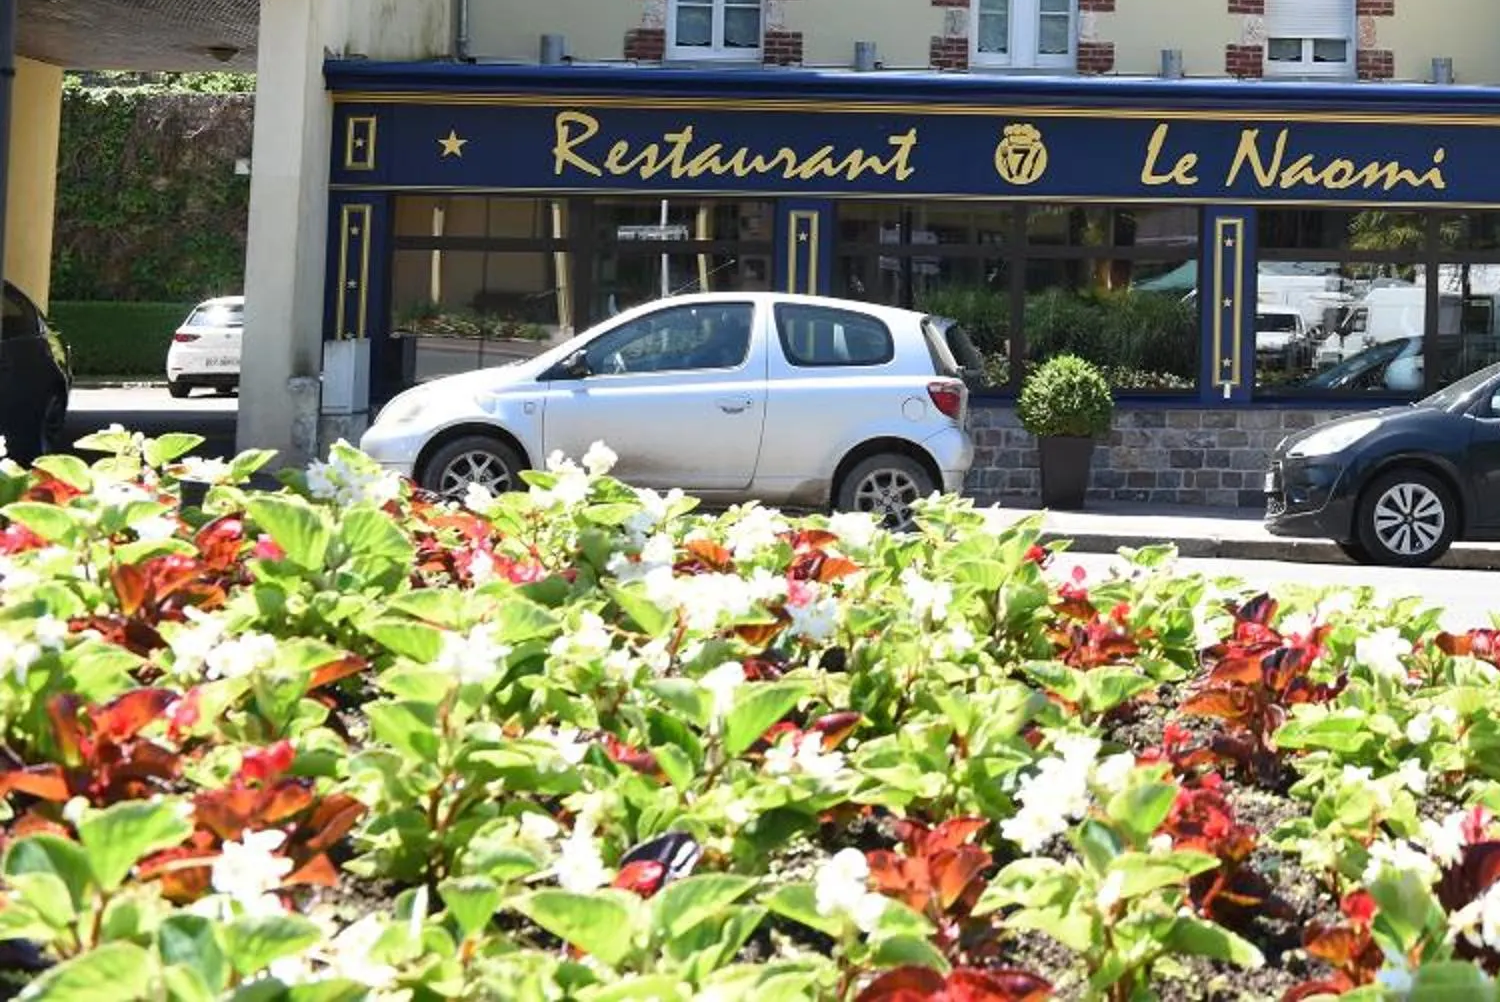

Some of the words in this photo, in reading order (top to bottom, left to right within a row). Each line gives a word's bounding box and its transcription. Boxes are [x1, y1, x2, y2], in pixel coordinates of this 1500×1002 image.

[552, 110, 917, 181] Restaurant
[1141, 123, 1199, 185] Le
[1225, 127, 1446, 190] Naomi
